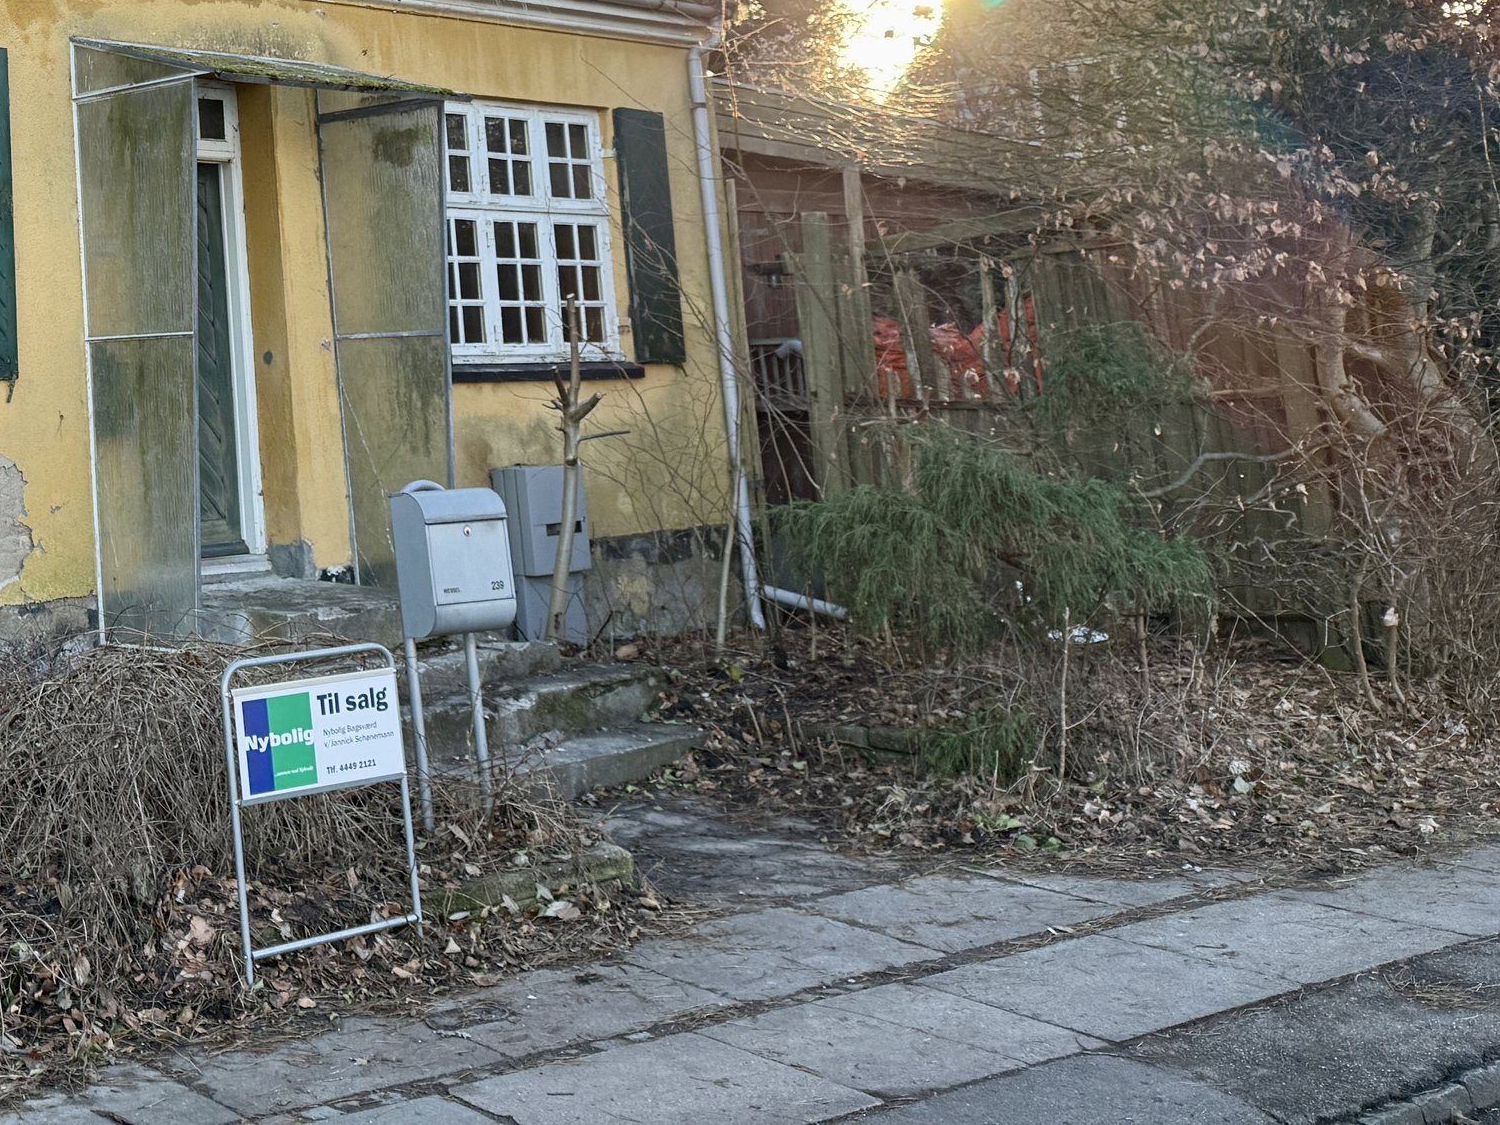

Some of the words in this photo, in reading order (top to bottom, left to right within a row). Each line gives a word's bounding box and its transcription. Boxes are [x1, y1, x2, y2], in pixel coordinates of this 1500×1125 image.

[491, 580, 504, 591] 239
[316, 692, 340, 715] Til
[345, 687, 388, 711] salg
[322, 726, 347, 738] Nybolig
[347, 721, 378, 733] Bagsværd
[245, 727, 315, 753] Nybolig
[326, 765, 338, 775] Tlf.
[340, 762, 358, 772] 4449
[359, 758, 377, 769] 2121
